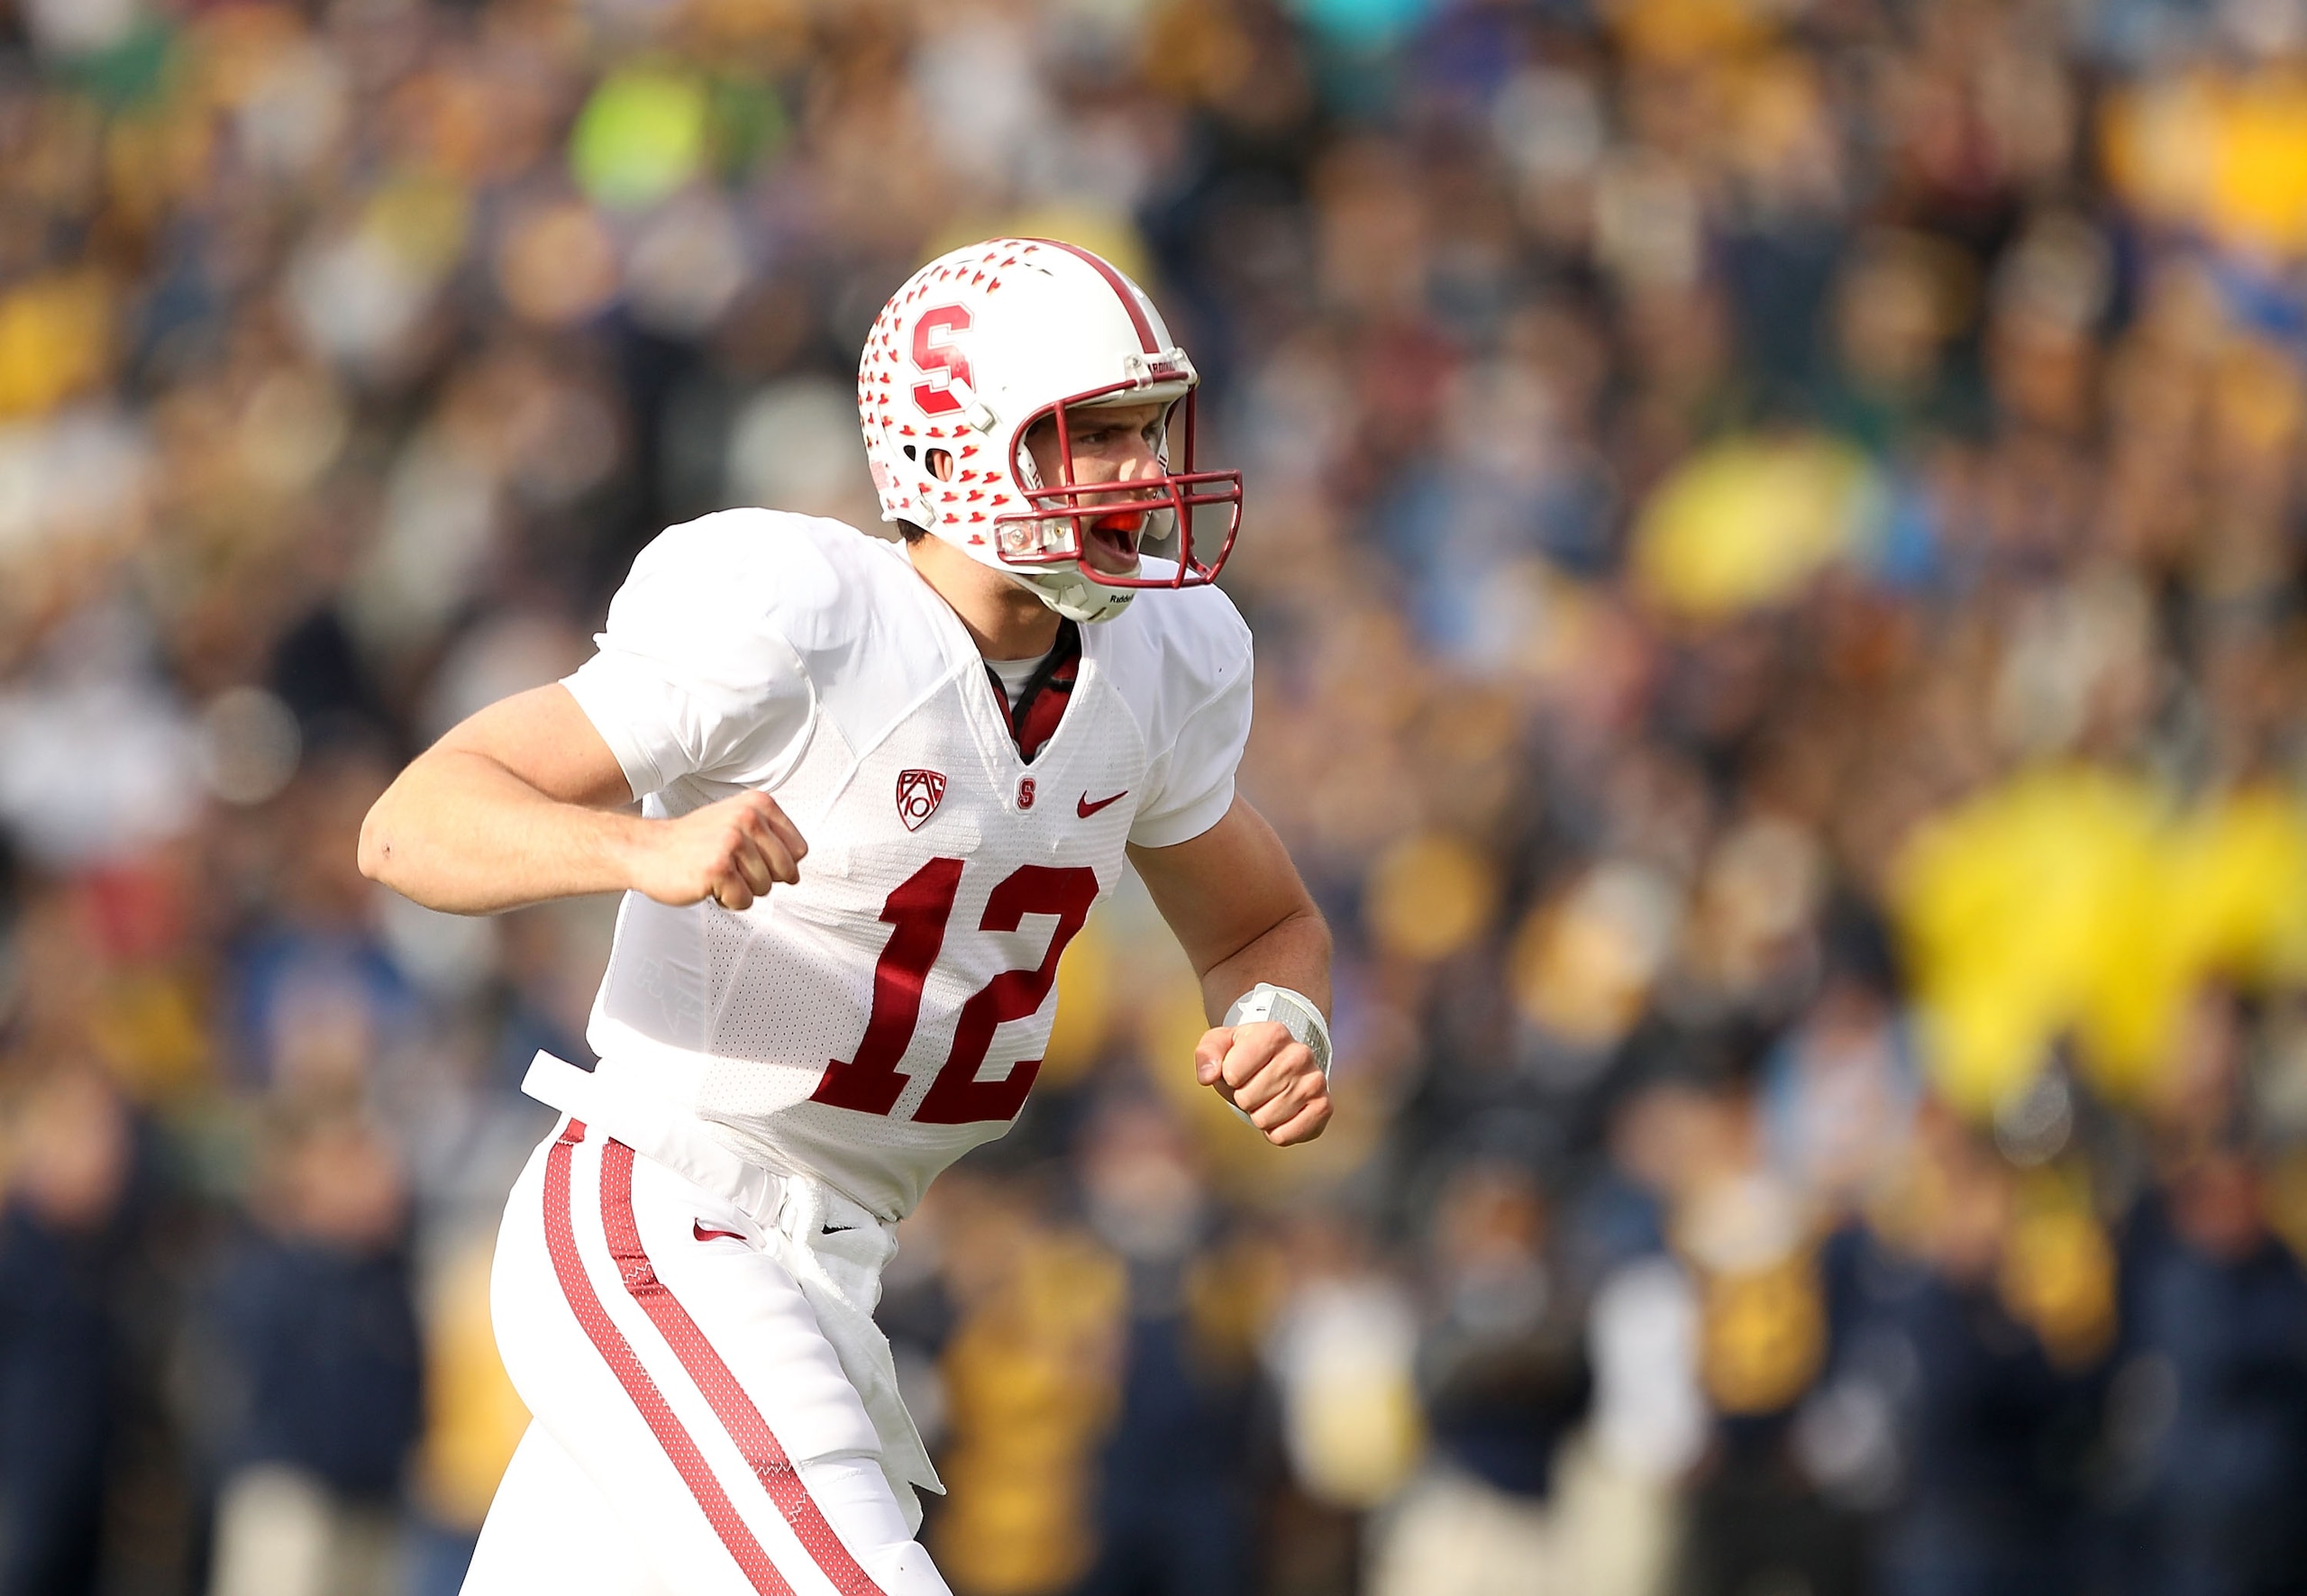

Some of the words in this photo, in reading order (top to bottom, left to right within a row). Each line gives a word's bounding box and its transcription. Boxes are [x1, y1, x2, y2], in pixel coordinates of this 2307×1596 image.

[909, 301, 976, 418] S
[899, 771, 944, 808] PAC
[904, 796, 930, 817] 10
[1017, 778, 1036, 809] S
[807, 857, 1099, 1124] 12
